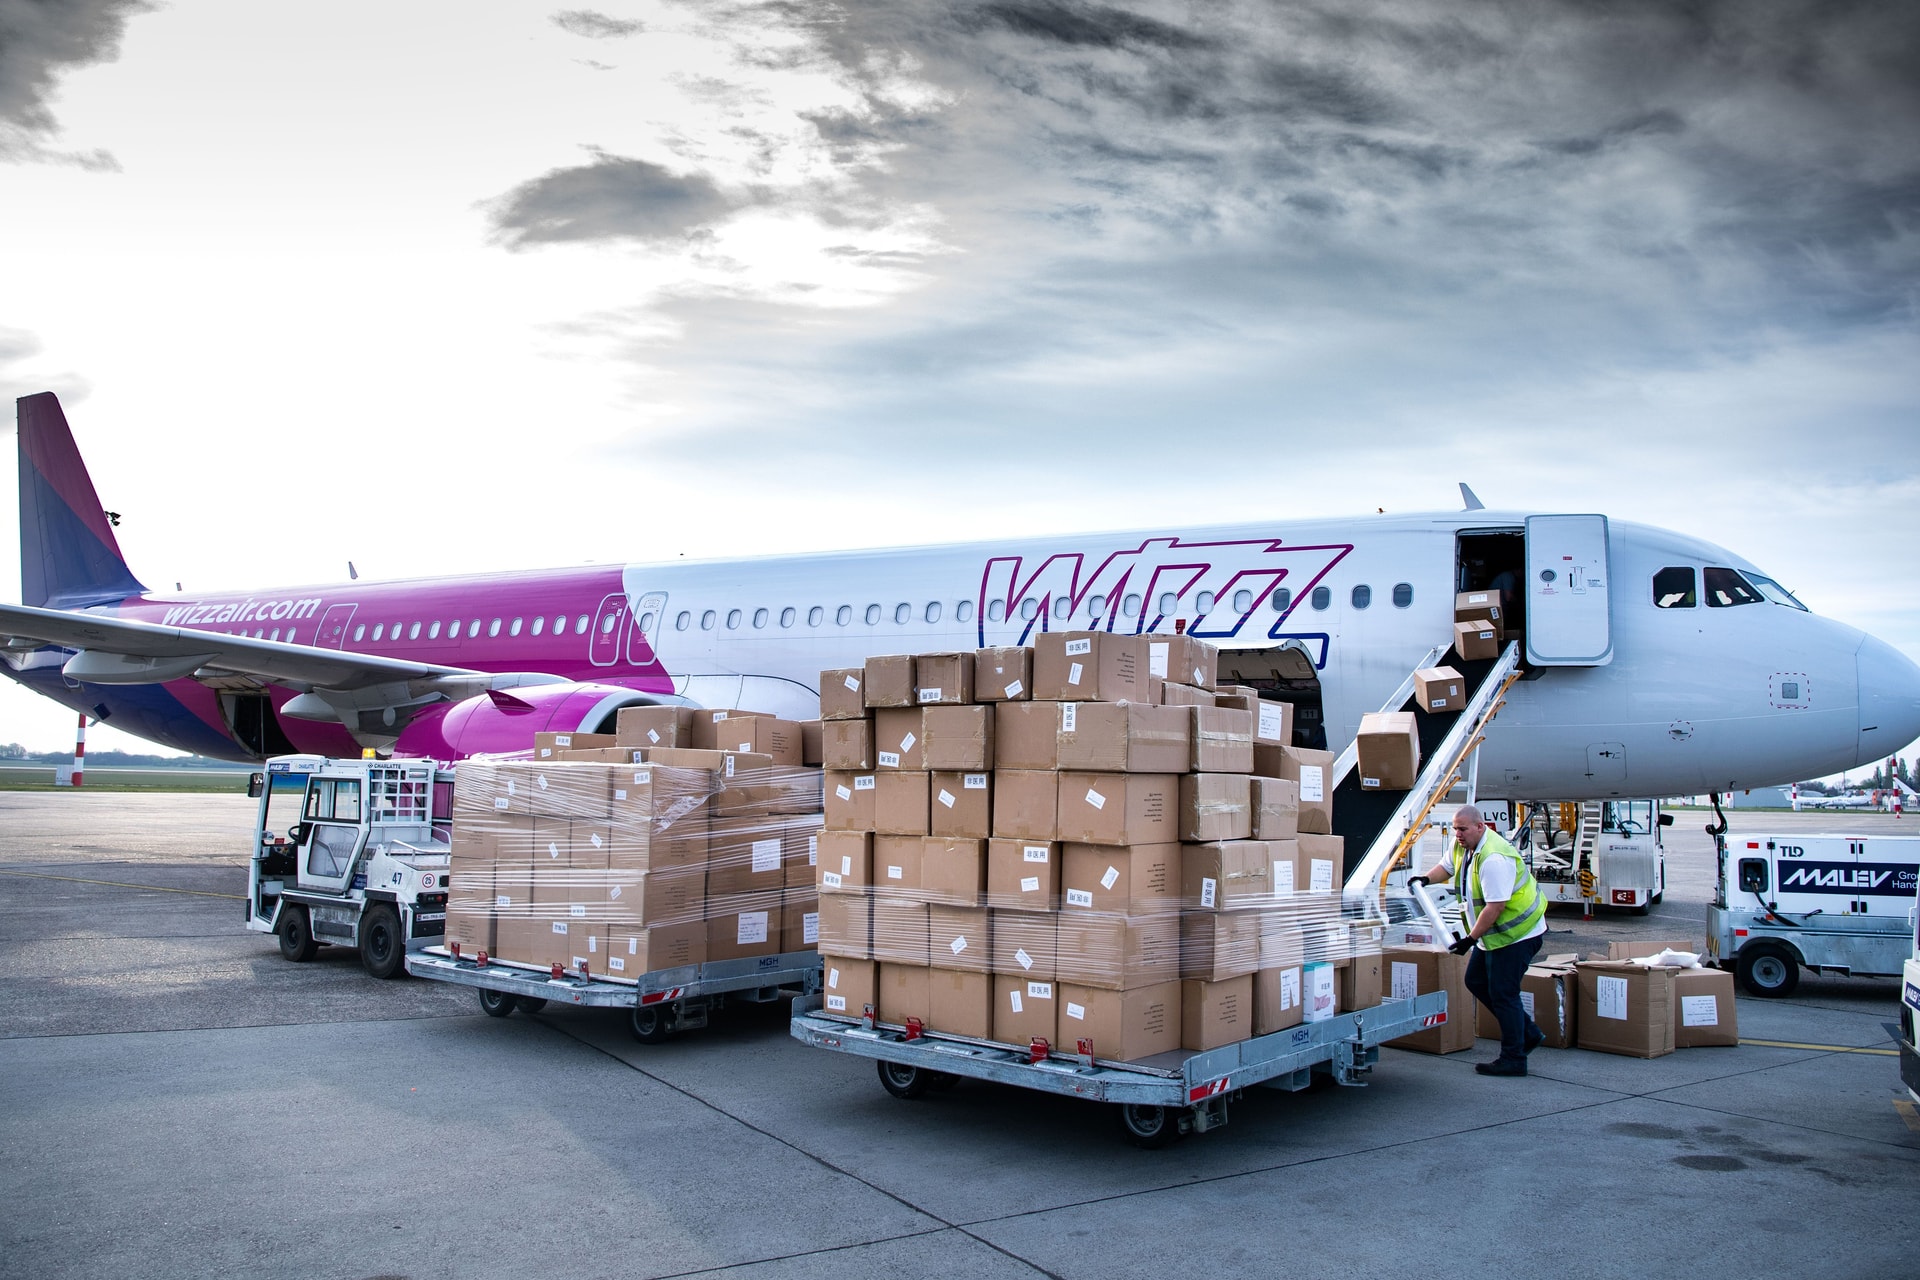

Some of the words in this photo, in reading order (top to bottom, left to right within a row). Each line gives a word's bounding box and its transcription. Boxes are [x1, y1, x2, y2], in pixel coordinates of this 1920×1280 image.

[162, 597, 322, 625] wizzair.com
[1484, 811, 1508, 821] LVC
[1780, 845, 1804, 857] TLD
[391, 872, 402, 885] 47
[424, 876, 432, 884] 25
[1898, 870, 1919, 880] Gro
[759, 956, 779, 967] MGH
[1291, 1029, 1309, 1042] MGH
